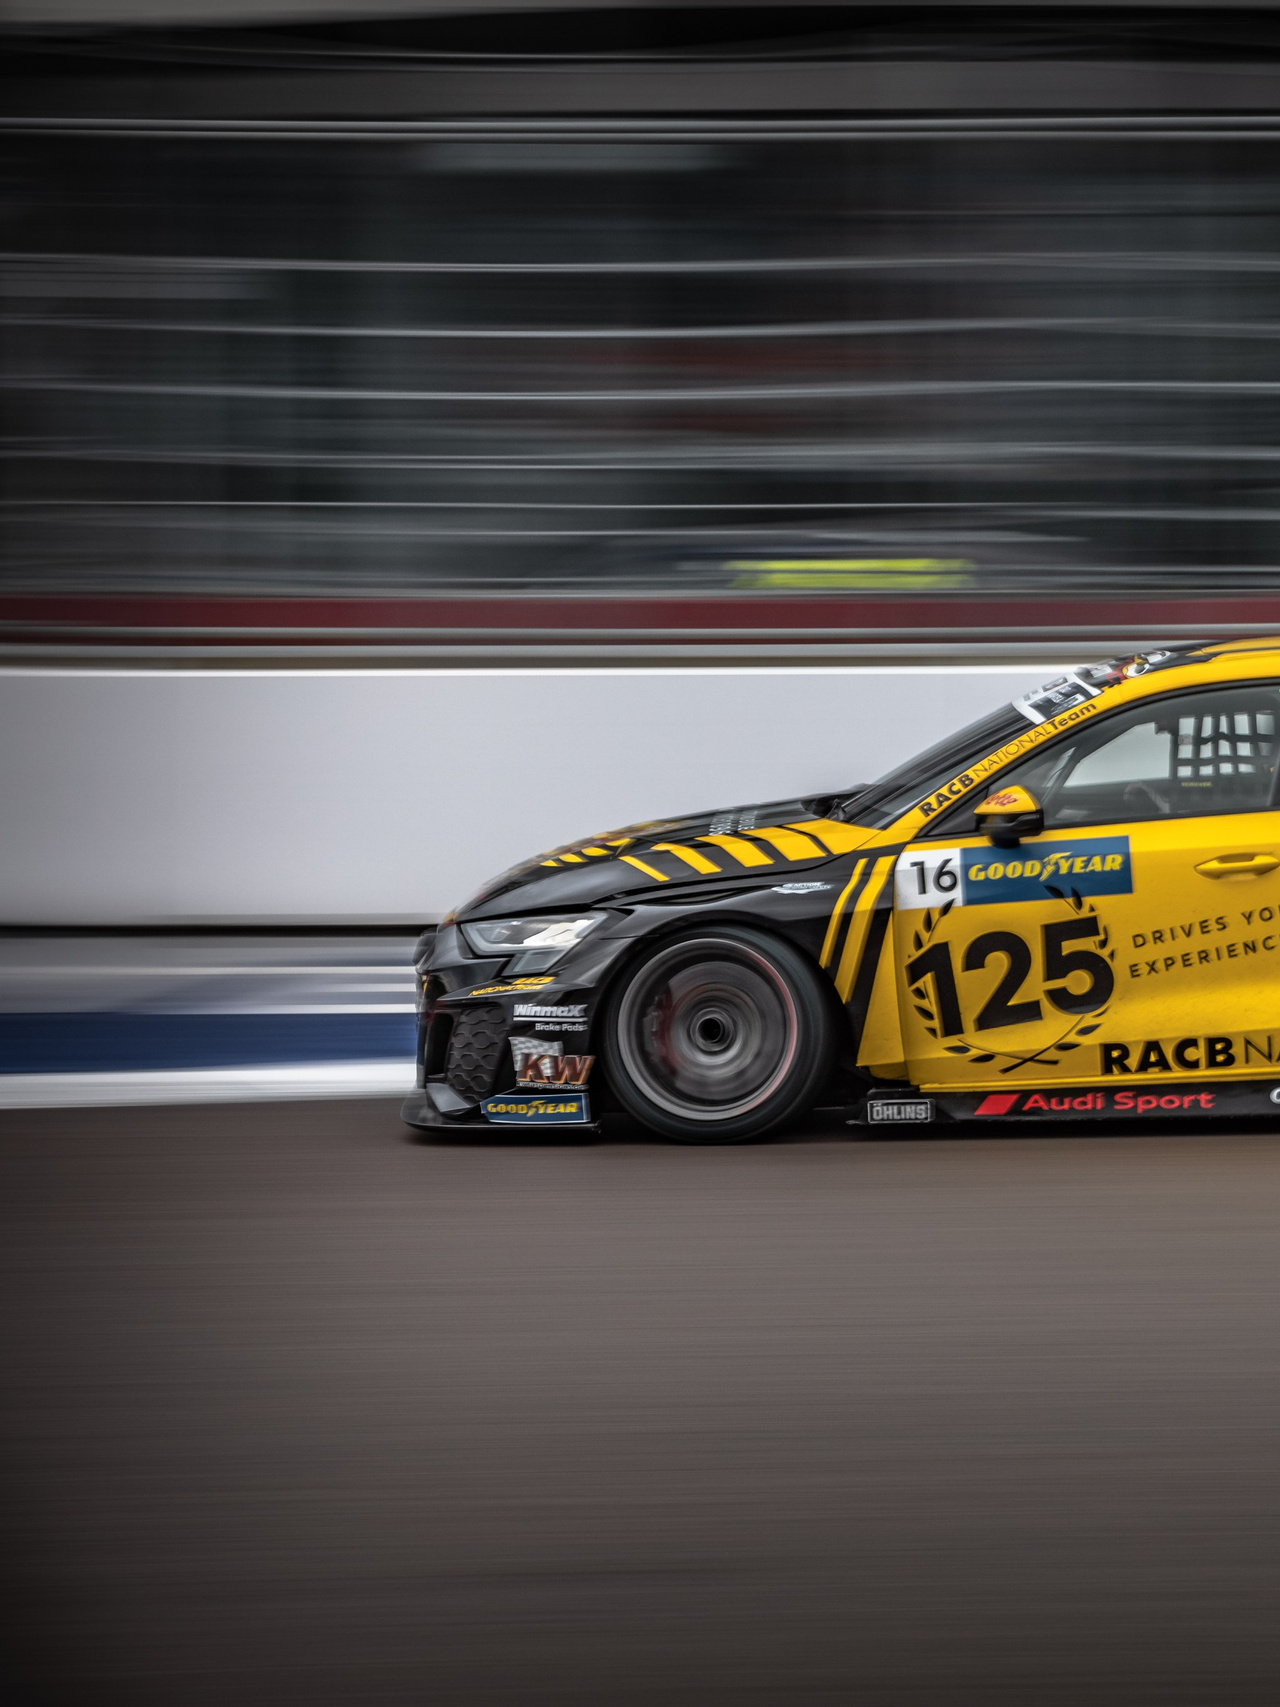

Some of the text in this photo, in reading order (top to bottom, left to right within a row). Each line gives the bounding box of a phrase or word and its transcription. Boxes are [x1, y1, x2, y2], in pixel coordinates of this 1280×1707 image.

[909, 858, 958, 895] 16
[1132, 914, 1228, 948] DRIVES
[905, 915, 1114, 1038] 125
[535, 1022, 588, 1032] Brake Pads
[516, 1053, 595, 1085] KW
[872, 1102, 928, 1121] ÖHLINS
[1022, 1091, 1217, 1113] Audi Sport
